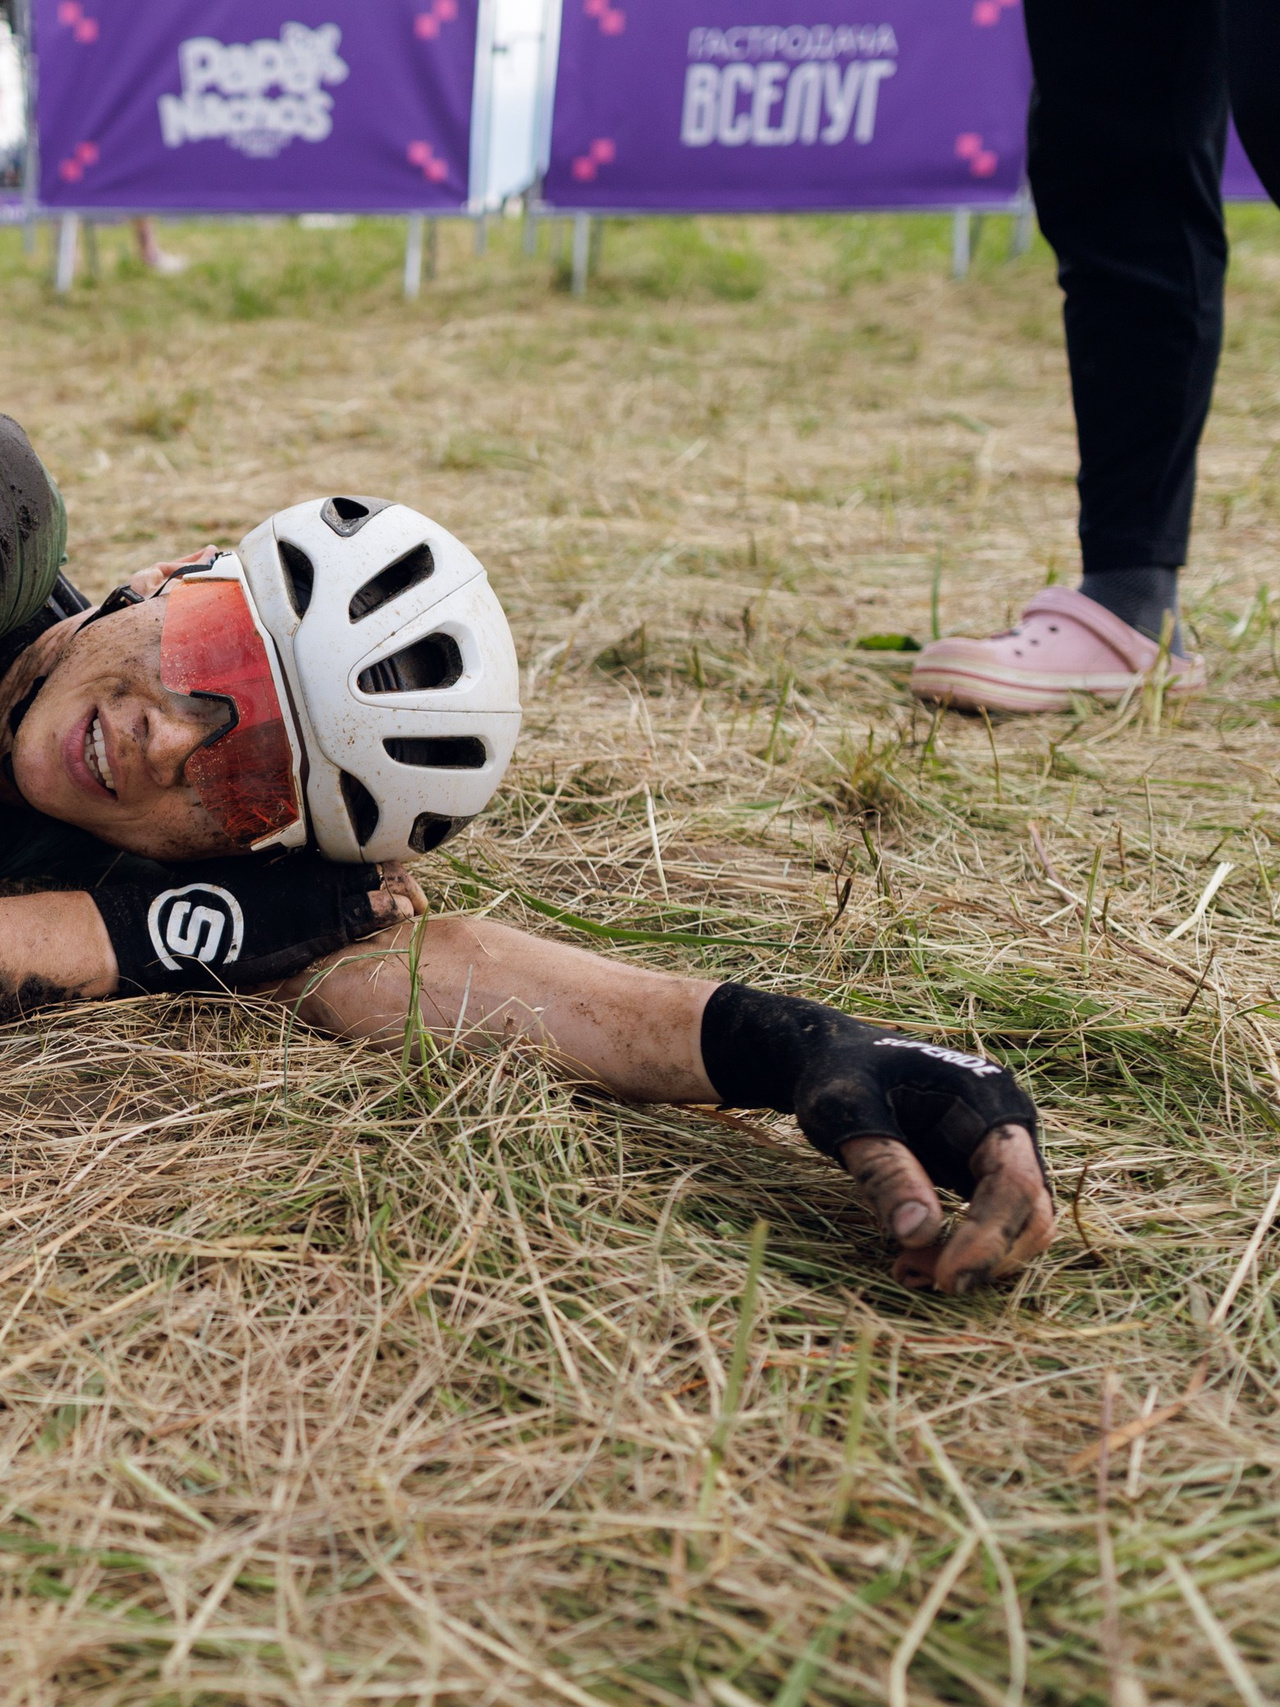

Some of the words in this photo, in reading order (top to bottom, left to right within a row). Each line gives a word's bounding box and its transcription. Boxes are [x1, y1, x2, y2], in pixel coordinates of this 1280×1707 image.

[687, 24, 898, 59] ГАСТРОДАЧА
[680, 60, 897, 146] ВСЕЛУГ
[873, 1037, 1002, 1078] SUPERIDE
